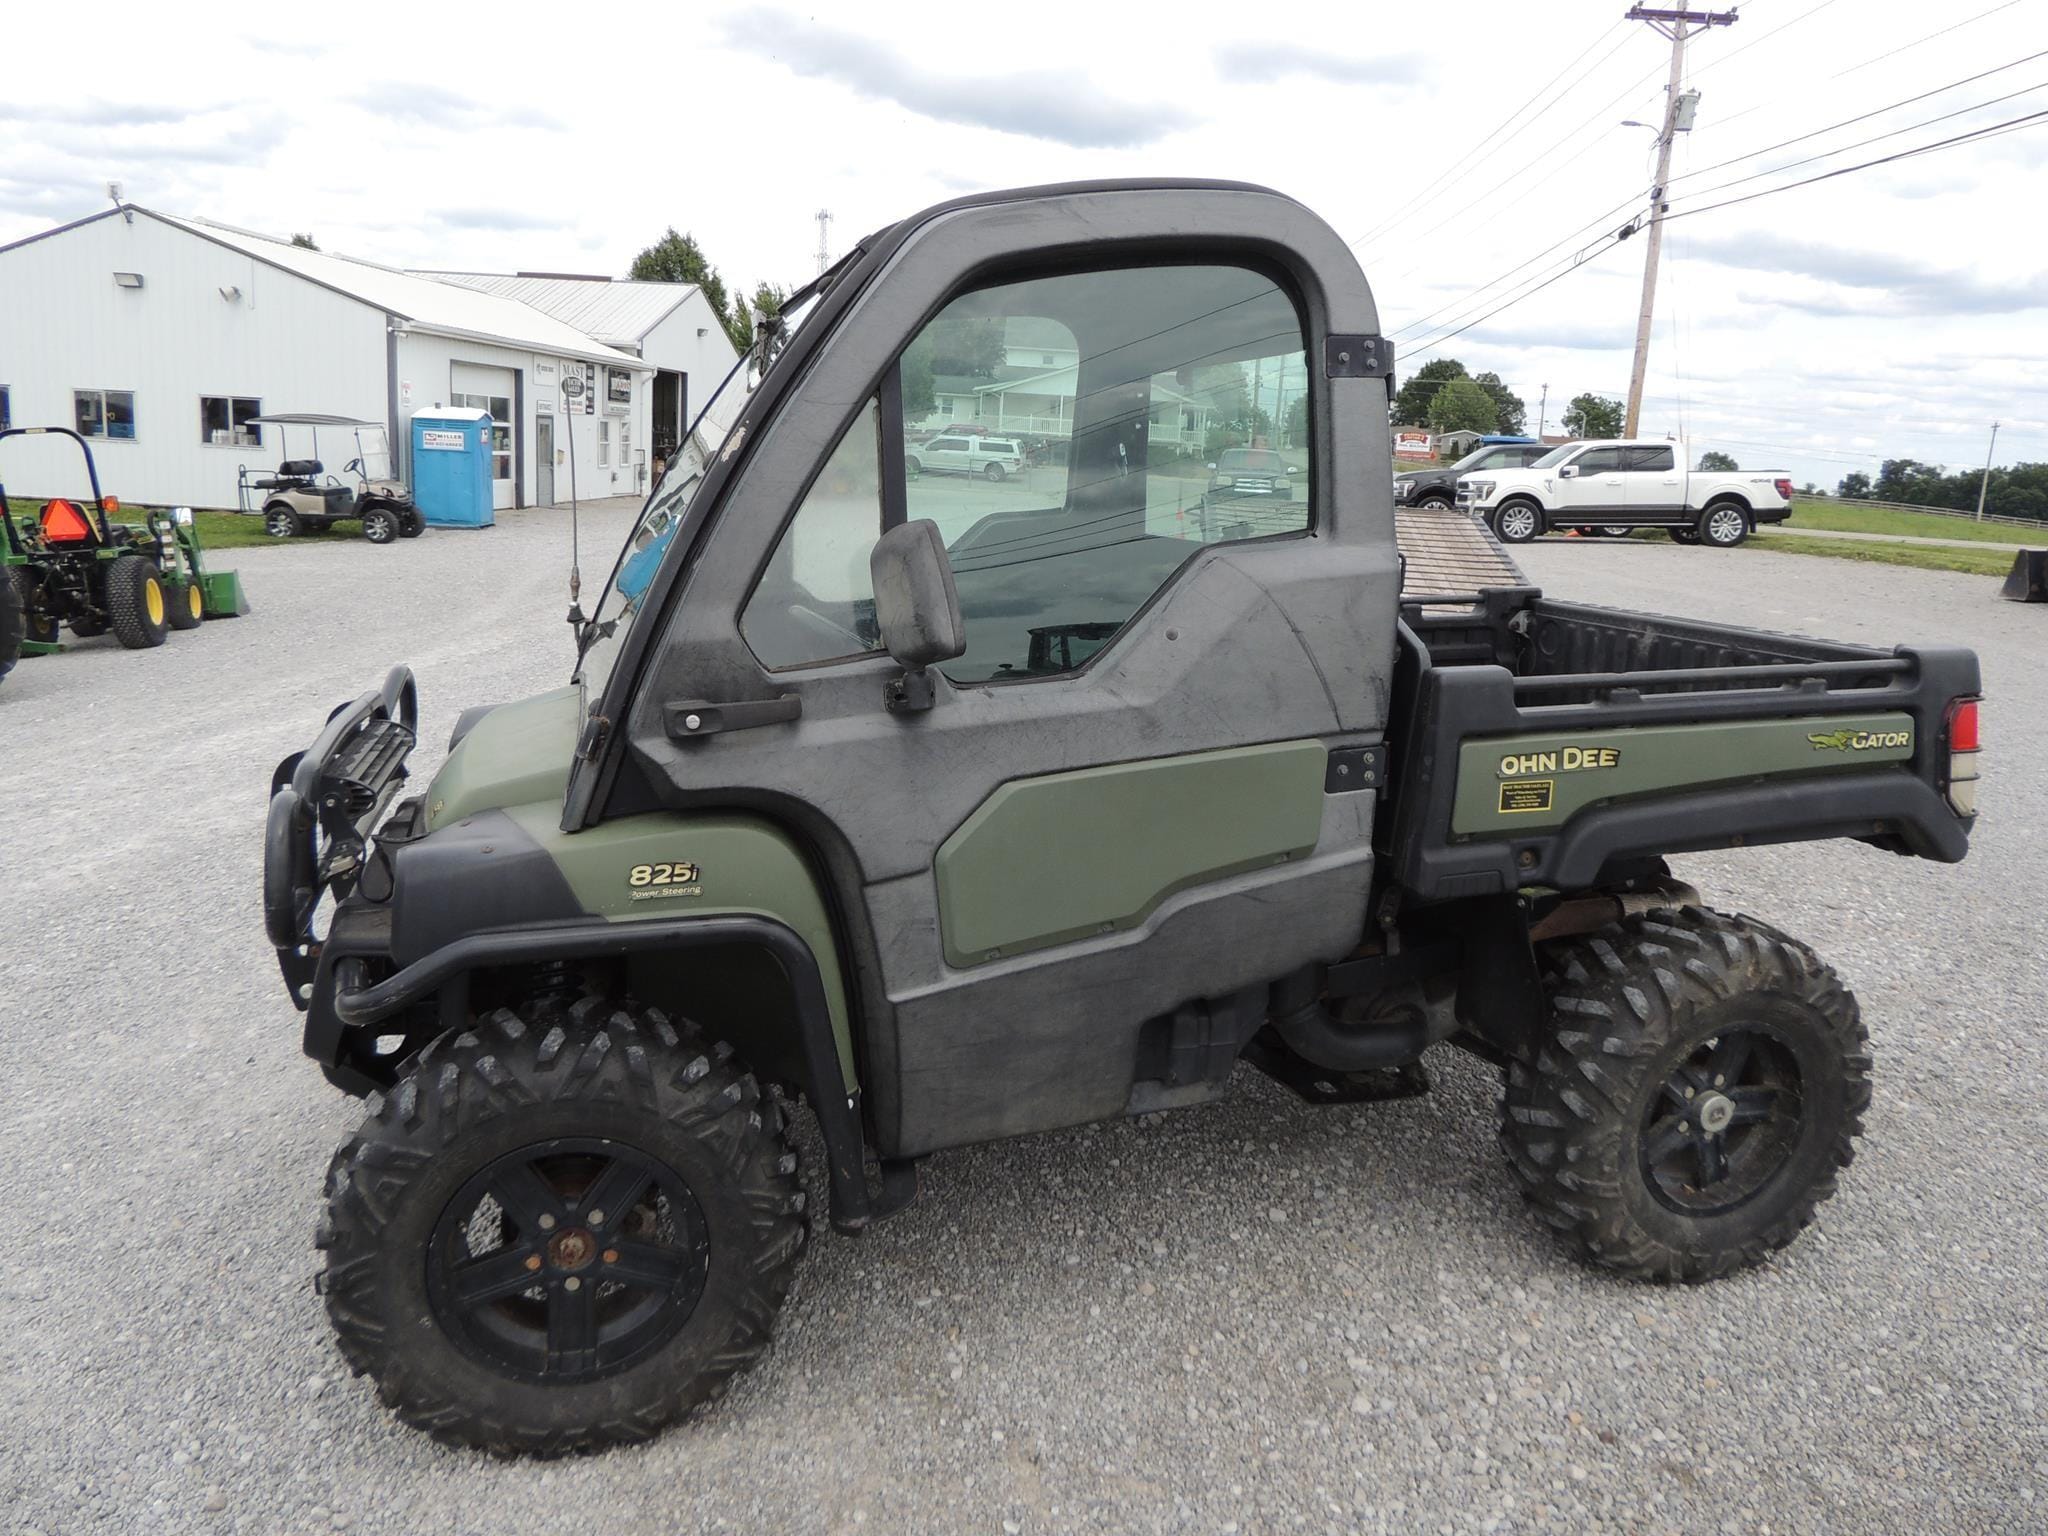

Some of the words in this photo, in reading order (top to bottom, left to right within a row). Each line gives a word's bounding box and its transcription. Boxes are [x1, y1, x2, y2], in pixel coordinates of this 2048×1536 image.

[563, 364, 584, 378] MAST
[1851, 731, 1910, 750] GATOR
[629, 863, 699, 887] 825i
[662, 886, 702, 897] Steering
